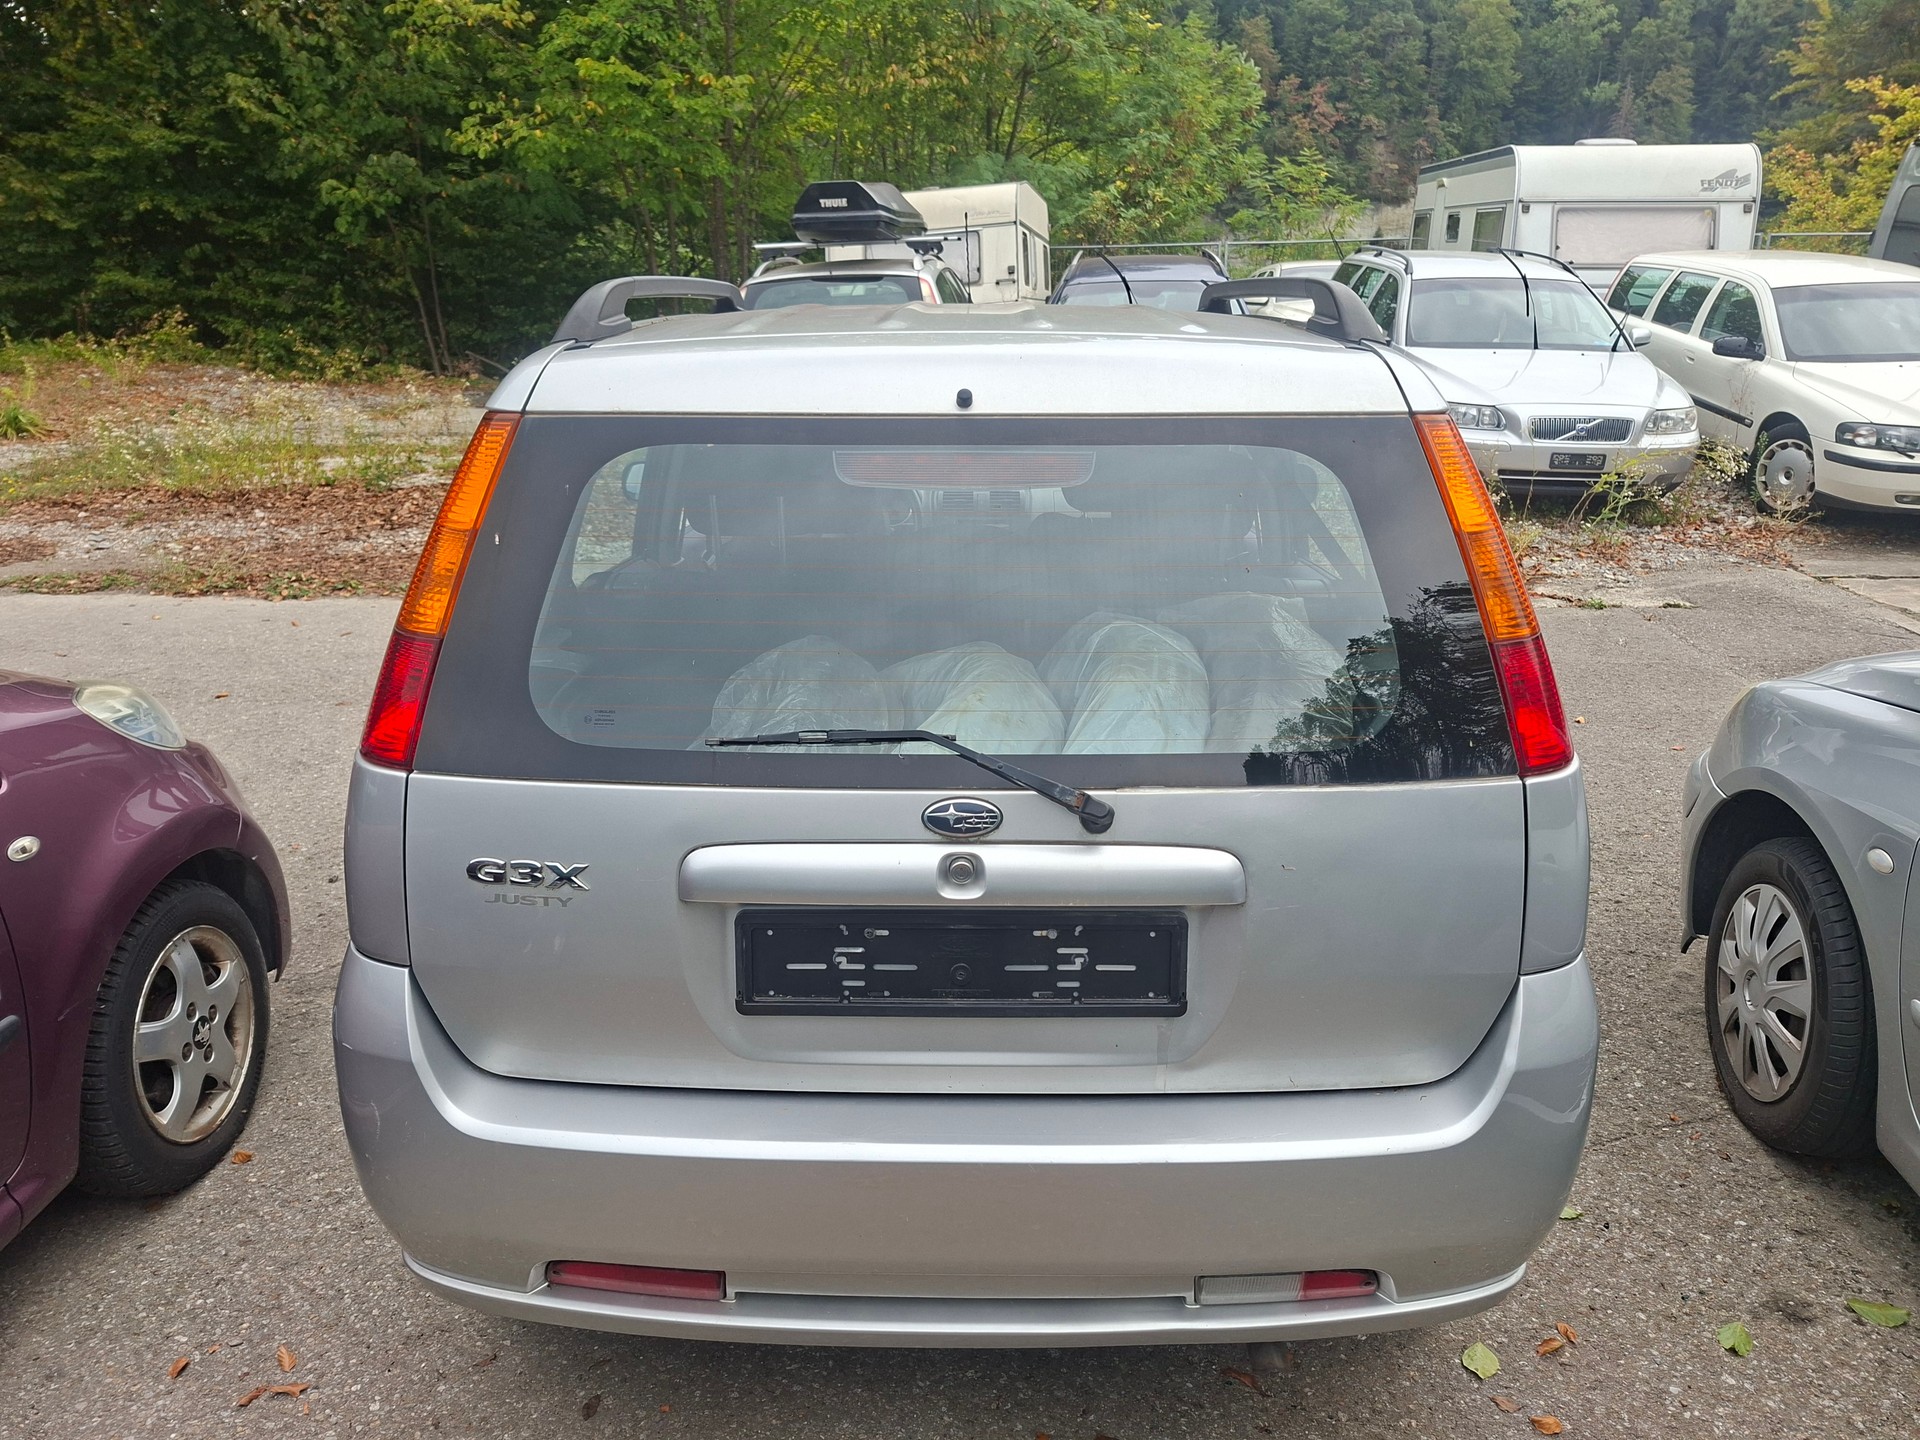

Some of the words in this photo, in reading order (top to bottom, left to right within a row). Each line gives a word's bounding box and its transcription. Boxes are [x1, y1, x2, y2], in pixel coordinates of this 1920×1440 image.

[819, 198, 848, 208] THULE
[466, 857, 590, 891] G3X
[484, 893, 573, 907] JUSTY
